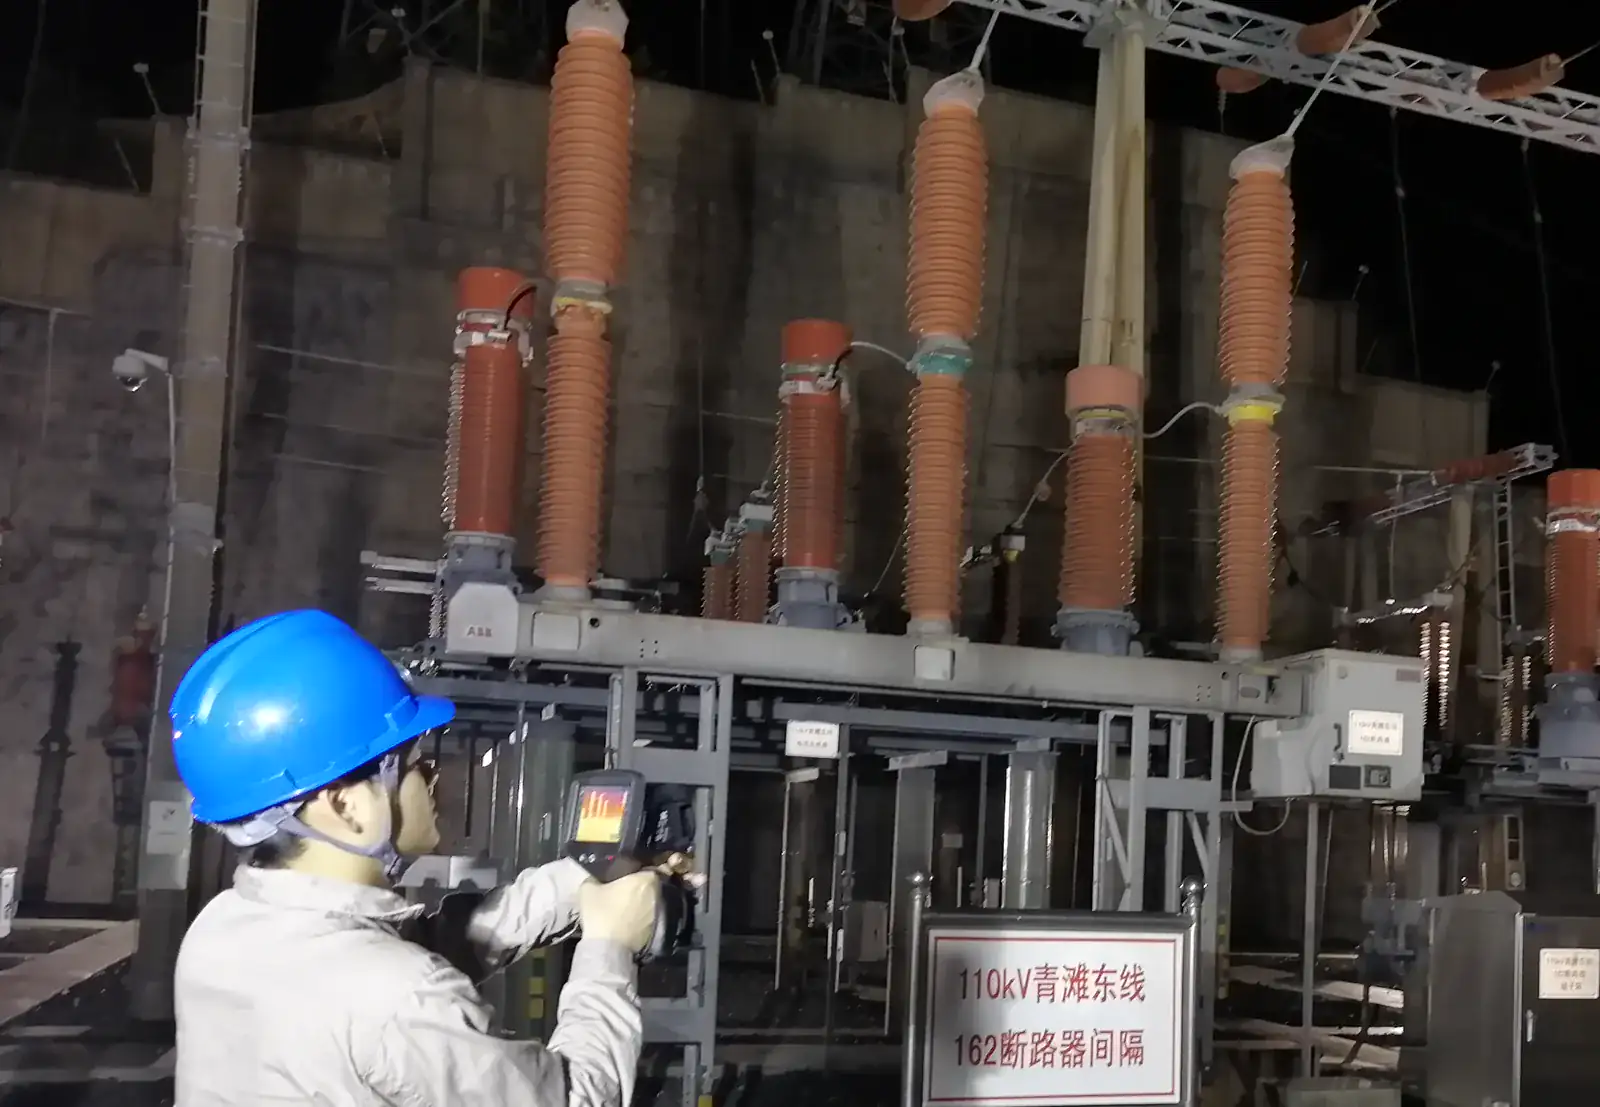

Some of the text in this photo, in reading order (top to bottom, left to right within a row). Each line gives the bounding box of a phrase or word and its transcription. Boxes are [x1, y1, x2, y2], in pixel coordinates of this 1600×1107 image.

[959, 962, 1146, 1004] 110kV青滩东线
[955, 1028, 1145, 1069] 162断路器间隔
